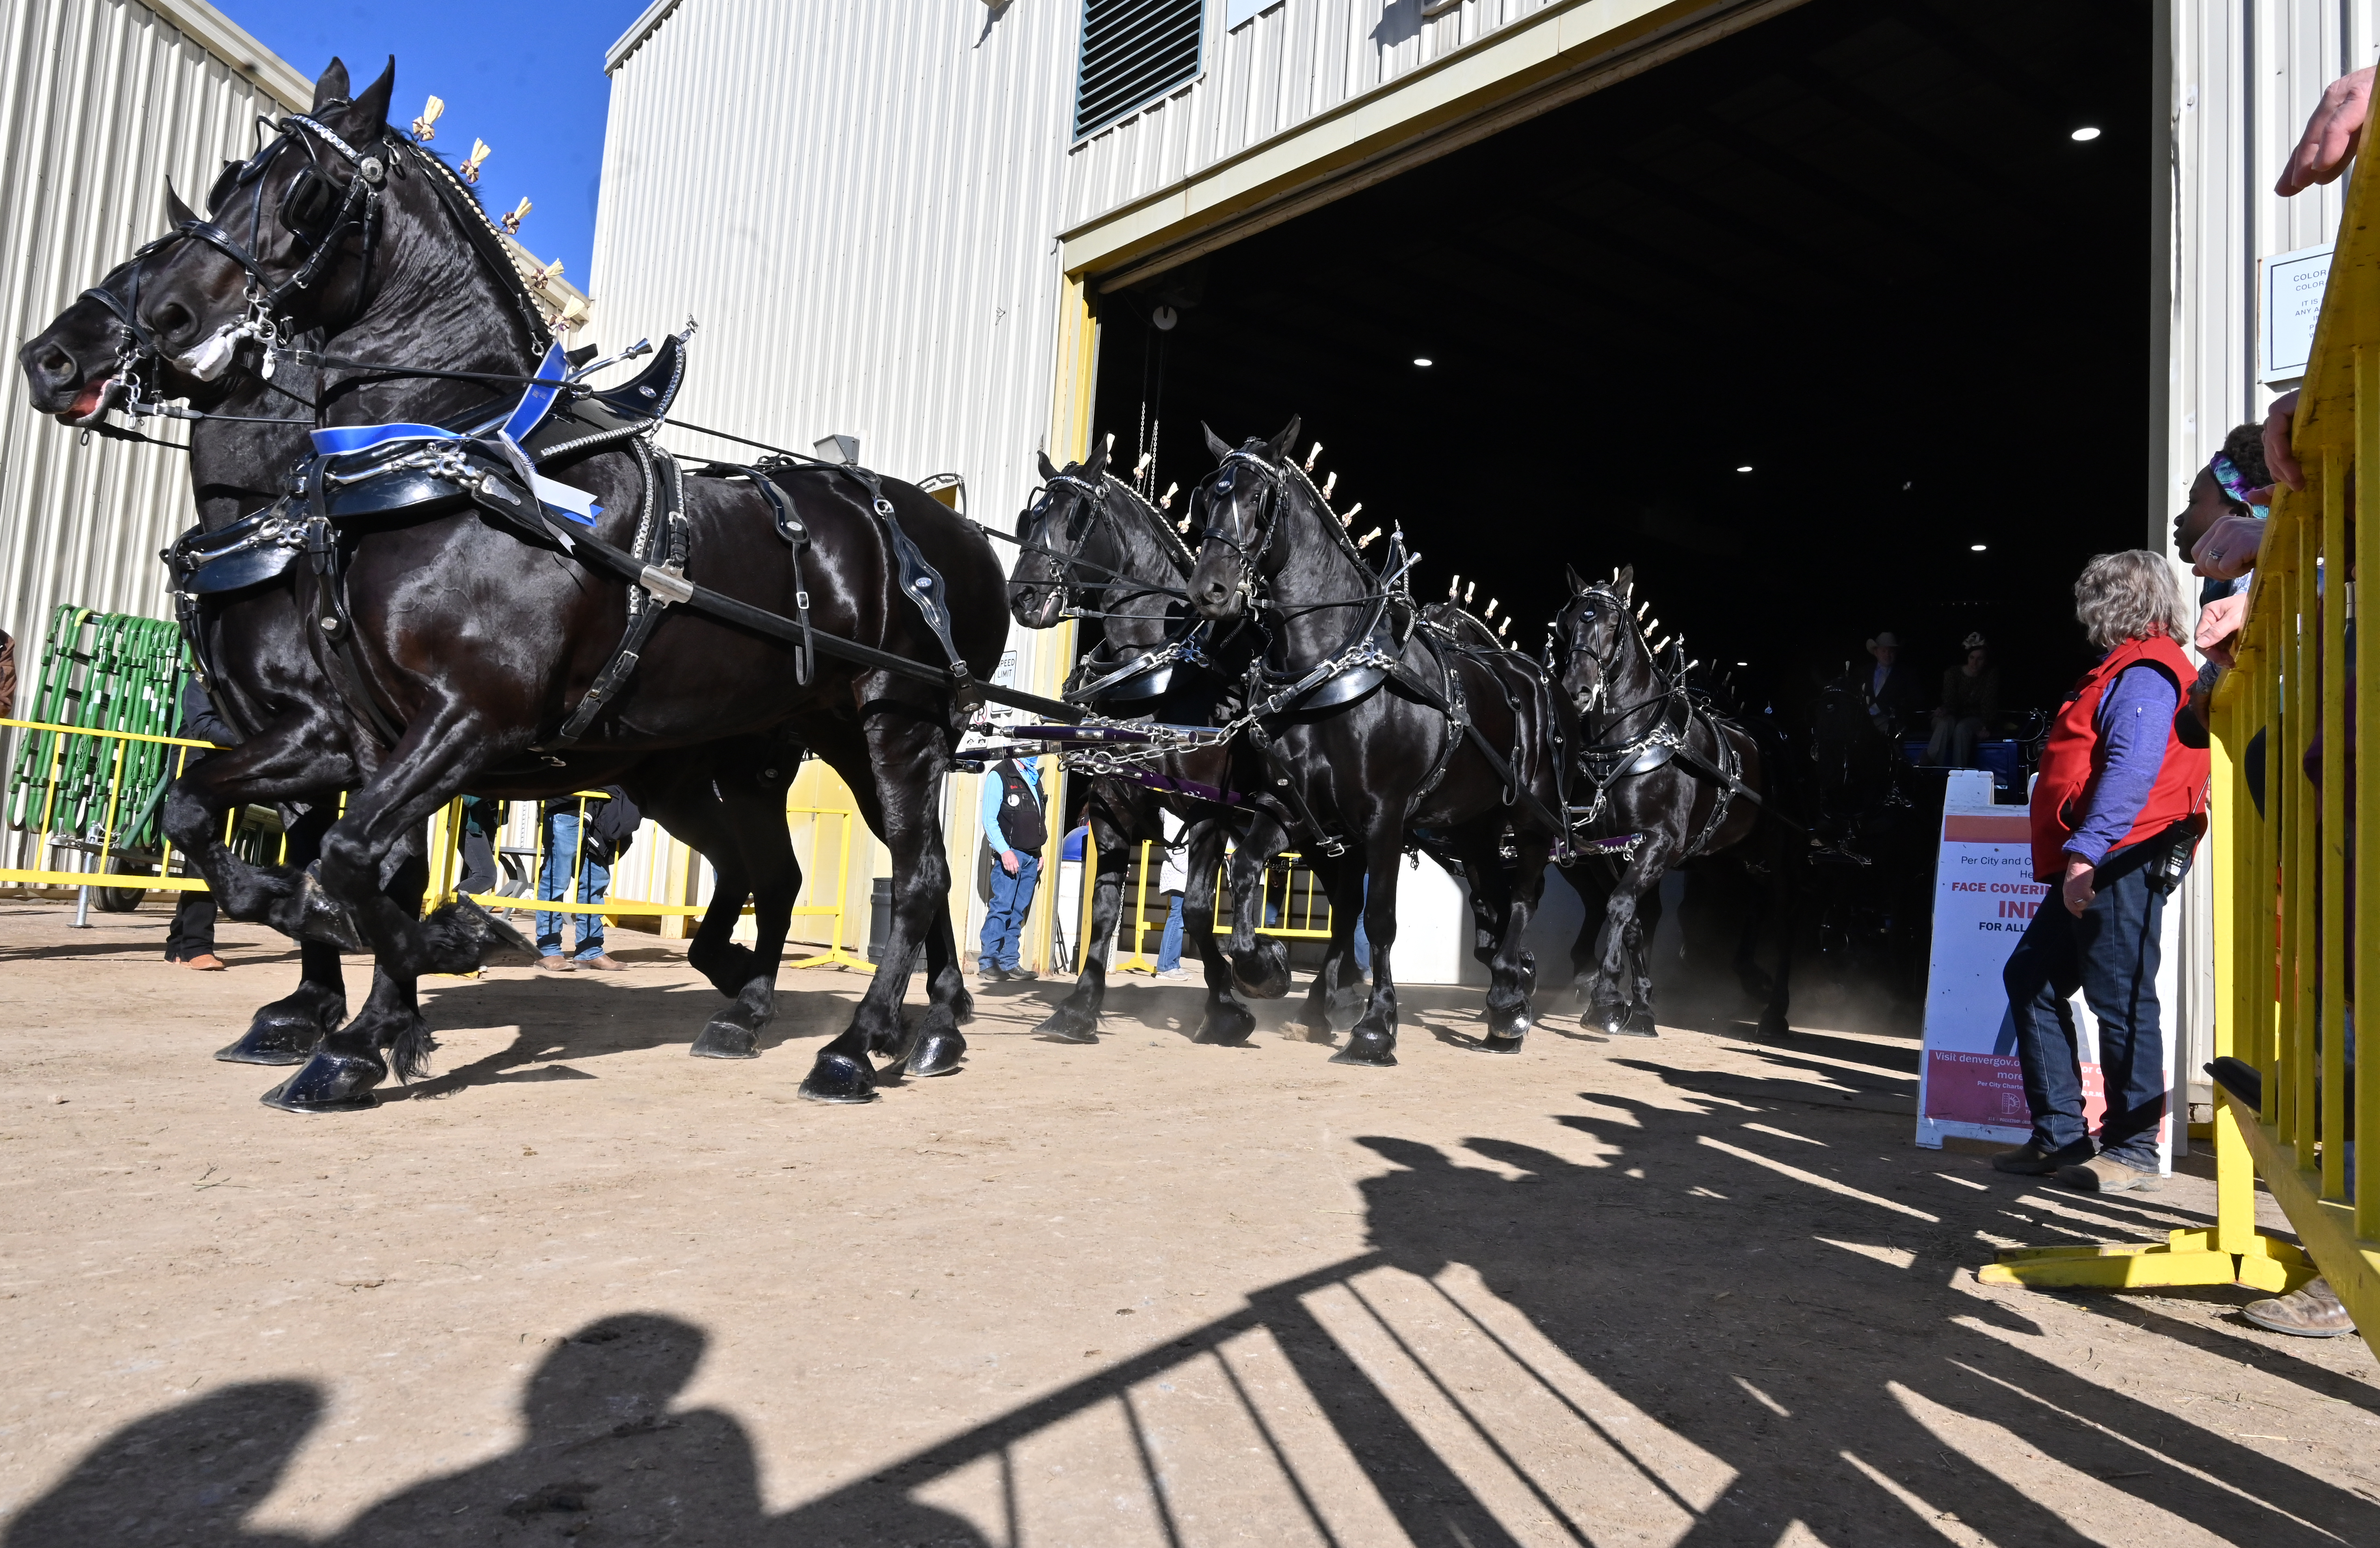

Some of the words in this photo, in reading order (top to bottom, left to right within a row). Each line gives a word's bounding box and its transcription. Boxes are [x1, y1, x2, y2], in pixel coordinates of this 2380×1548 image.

[2293, 269, 2326, 282] COLOR
[2295, 308, 2311, 316] ANY
[998, 670, 1012, 678] LIMIT
[1961, 856, 1978, 865] Per
[1980, 856, 1999, 866] City
[1952, 882, 1986, 892] FACE
[1979, 922, 2002, 931] FOR
[2005, 923, 2027, 932] ALL
[1935, 1052, 1957, 1062] Visit
[1997, 1072, 2023, 1081] more
